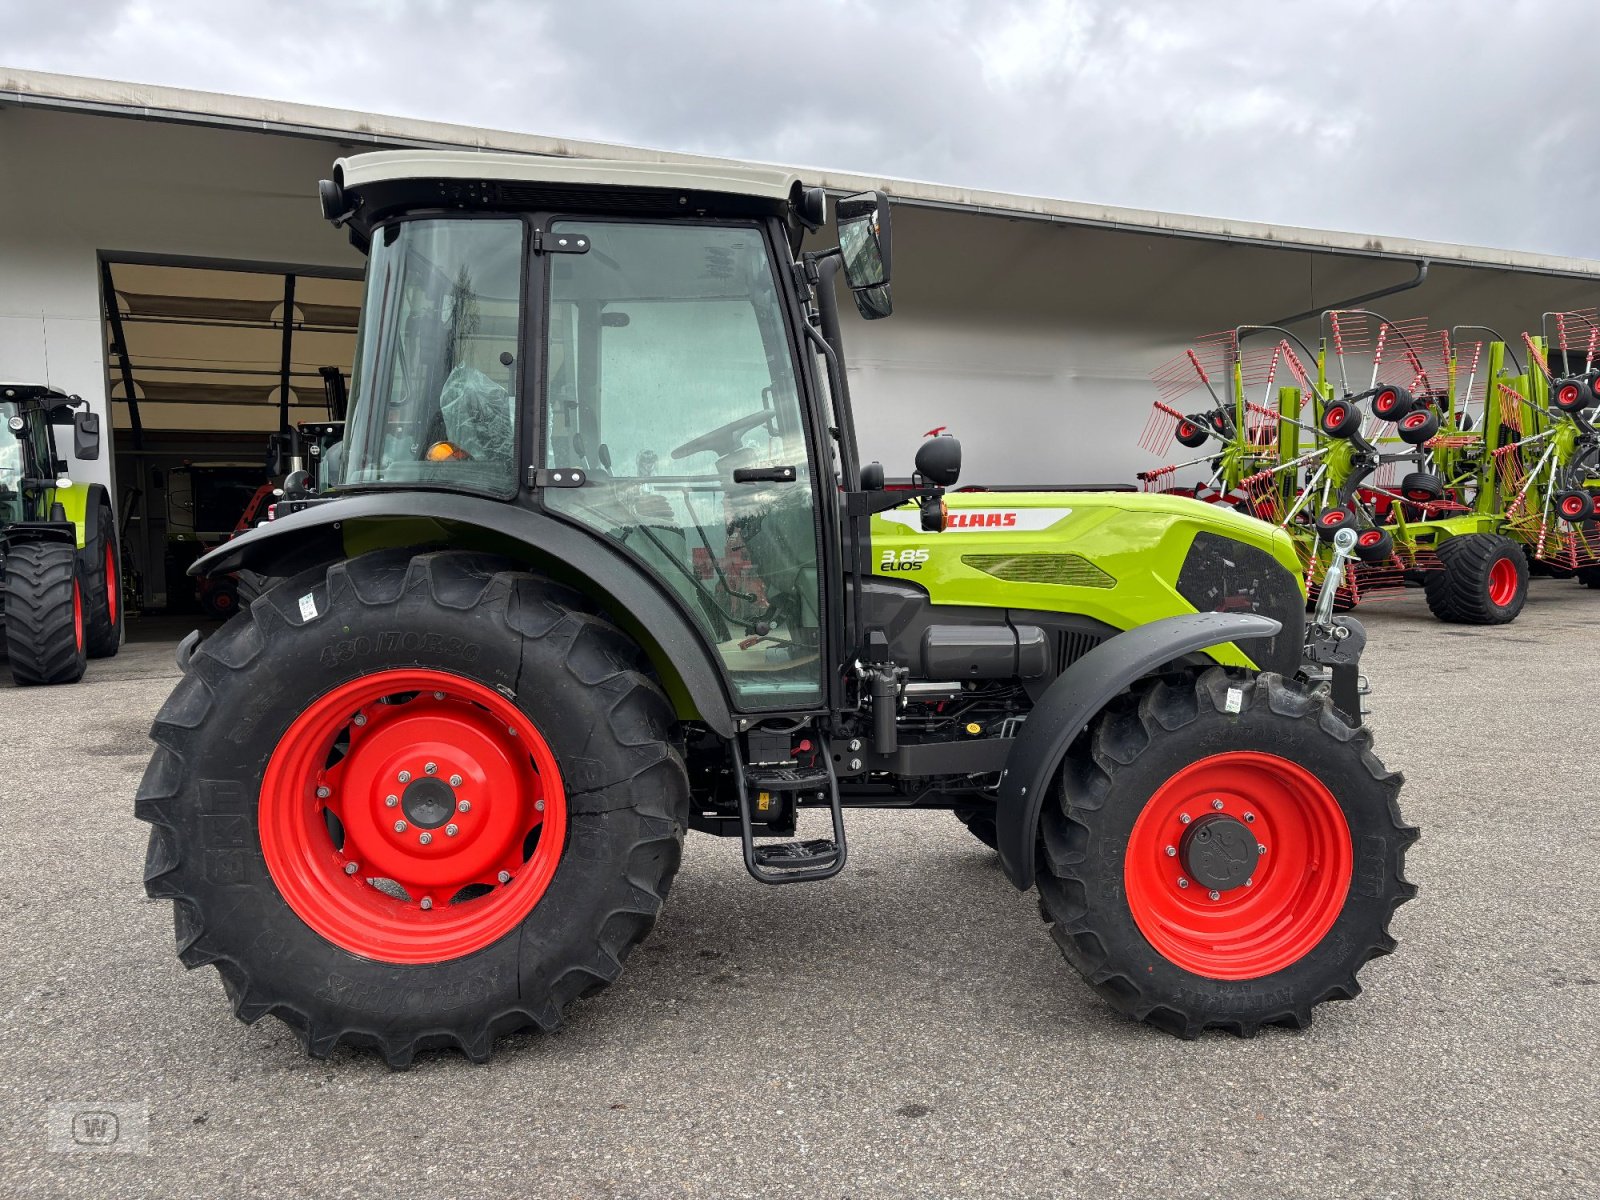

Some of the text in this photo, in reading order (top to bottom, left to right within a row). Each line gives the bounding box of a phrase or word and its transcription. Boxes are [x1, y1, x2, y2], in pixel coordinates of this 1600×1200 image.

[947, 513, 1017, 528] CLAAS
[881, 549, 930, 563] 3.85
[880, 561, 923, 572] ELIOS
